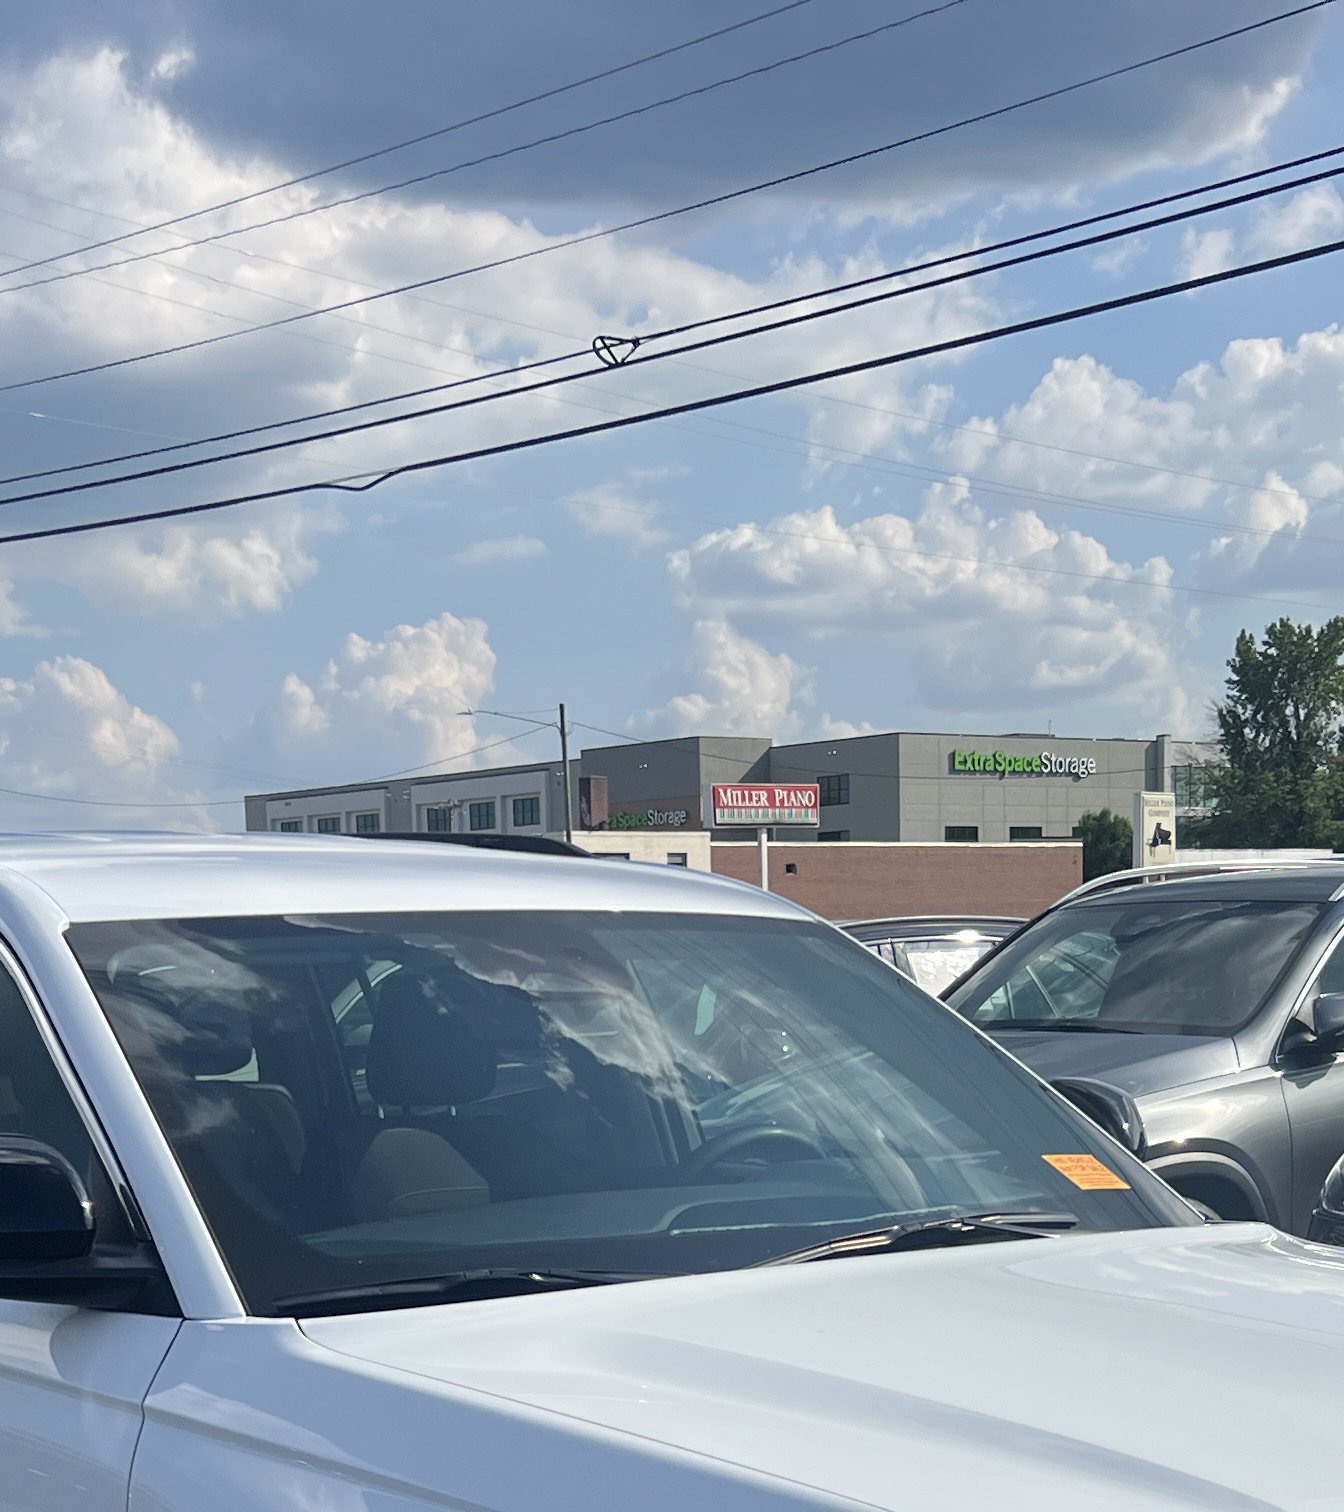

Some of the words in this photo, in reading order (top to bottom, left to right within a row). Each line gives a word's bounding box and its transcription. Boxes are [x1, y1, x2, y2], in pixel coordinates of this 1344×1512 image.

[954, 749, 1097, 778] ExtraSpaceStorage
[718, 788, 769, 807] MILLER
[774, 788, 816, 807] PIANO
